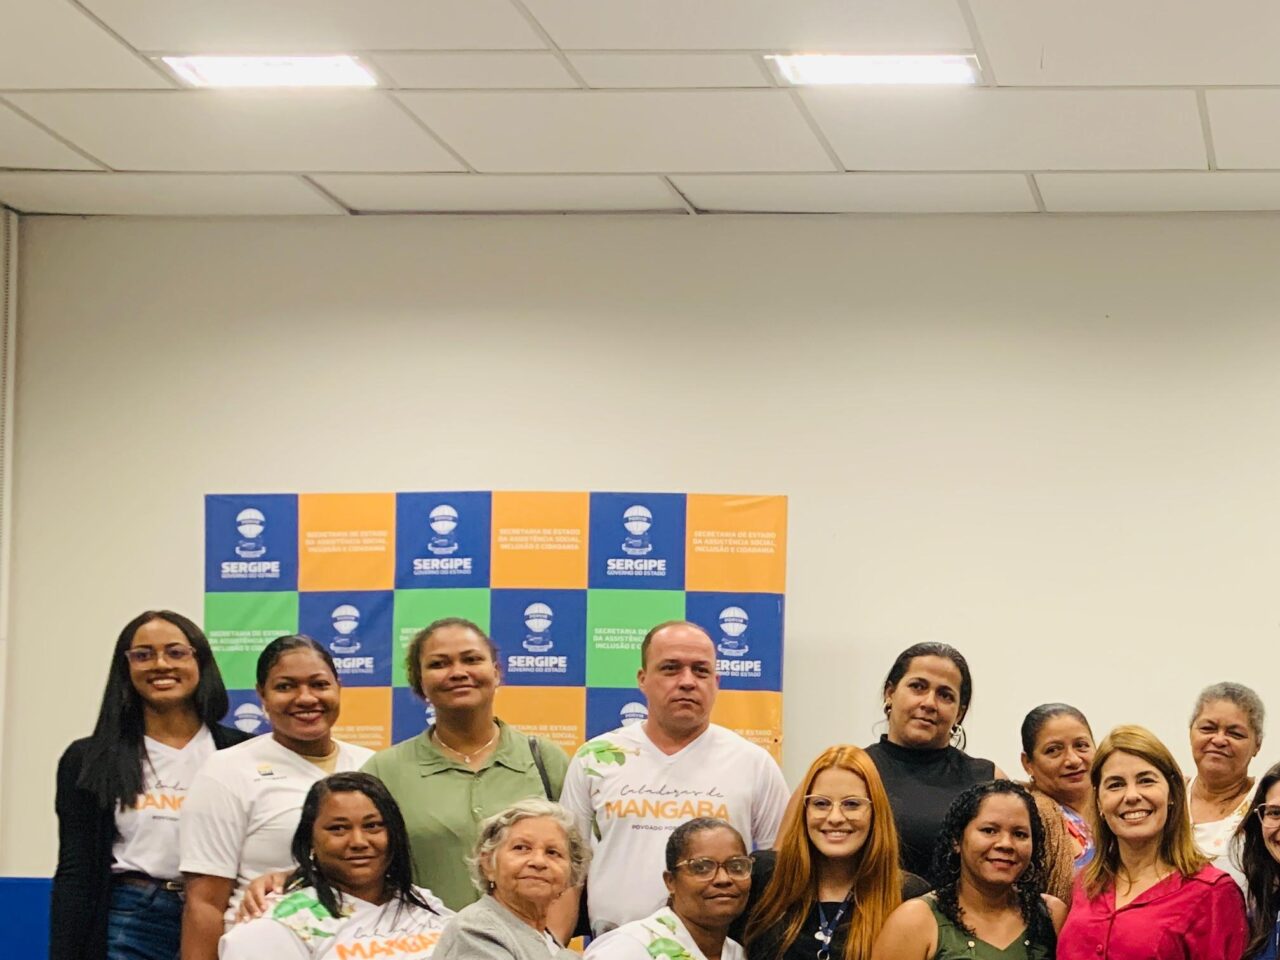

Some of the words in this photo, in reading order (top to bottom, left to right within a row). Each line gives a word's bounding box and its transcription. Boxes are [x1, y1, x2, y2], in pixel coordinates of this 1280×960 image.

[221, 561, 280, 573] SERGIPE
[413, 558, 472, 570] SERGIPE
[607, 559, 666, 571] SERGIPE
[332, 656, 374, 668] RGIPE
[508, 655, 567, 667] SERGIPE
[715, 660, 762, 672] ERGIPE
[605, 799, 731, 823] MANGABA
